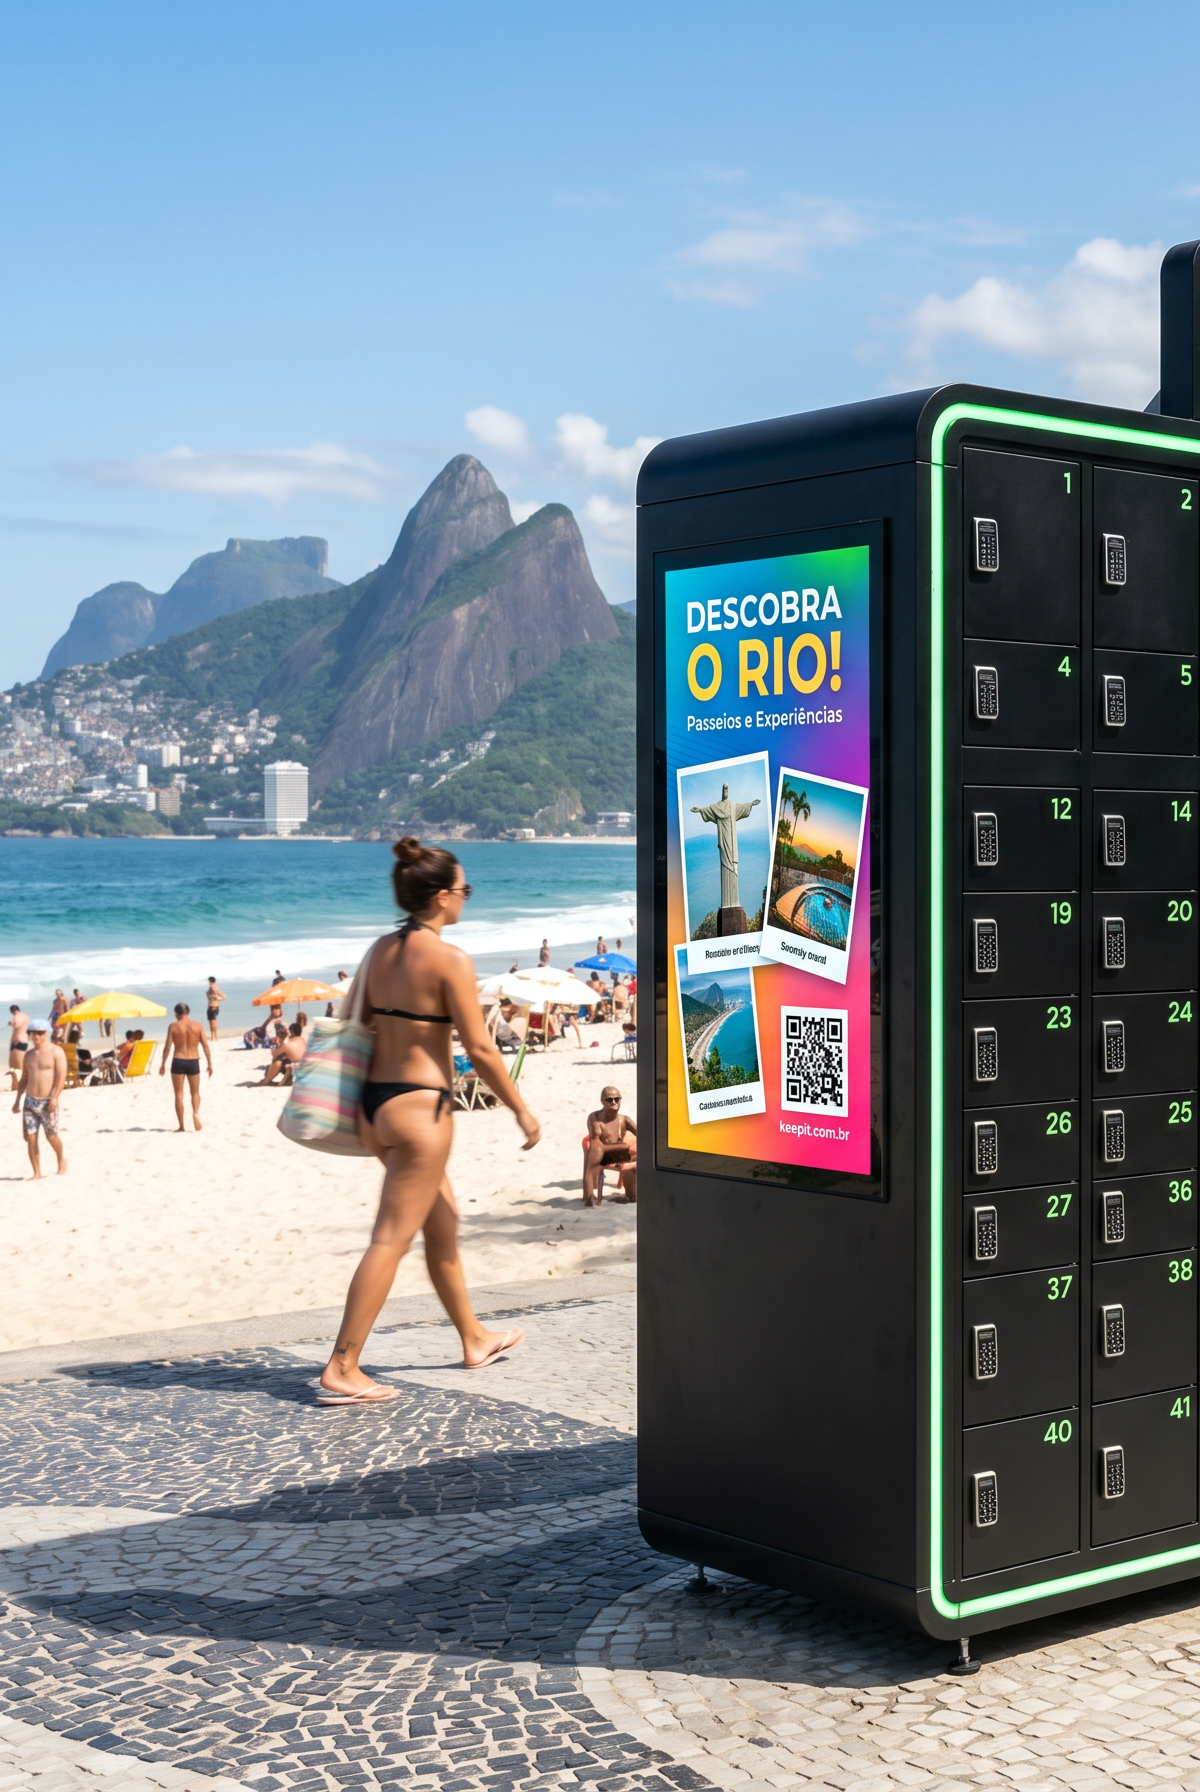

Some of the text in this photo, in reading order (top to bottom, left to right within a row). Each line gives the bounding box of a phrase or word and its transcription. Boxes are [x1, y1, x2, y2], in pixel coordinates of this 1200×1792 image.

[1063, 471, 1071, 494] 1
[1180, 488, 1193, 511] 2
[687, 585, 843, 634] DESCOBRA
[687, 631, 842, 702] O RIO!
[1057, 655, 1072, 678] 4
[1180, 664, 1193, 686] 5
[687, 706, 843, 732] Passeios e Experiências
[1051, 797, 1072, 820] 12
[1171, 800, 1192, 822] 14
[1050, 901, 1072, 925] 19
[1167, 899, 1193, 922] 20
[1046, 1005, 1072, 1030] 23
[1167, 1000, 1193, 1023] 24
[1045, 1110, 1072, 1136] 26
[1168, 1100, 1193, 1124] 25
[778, 1119, 850, 1141] keepit.com.br
[1168, 1179, 1193, 1203] 36
[1046, 1193, 1073, 1219] 27
[1168, 1258, 1193, 1284] 38
[1047, 1274, 1073, 1301] 37
[1169, 1395, 1191, 1419] 41
[1043, 1419, 1073, 1445] 40
